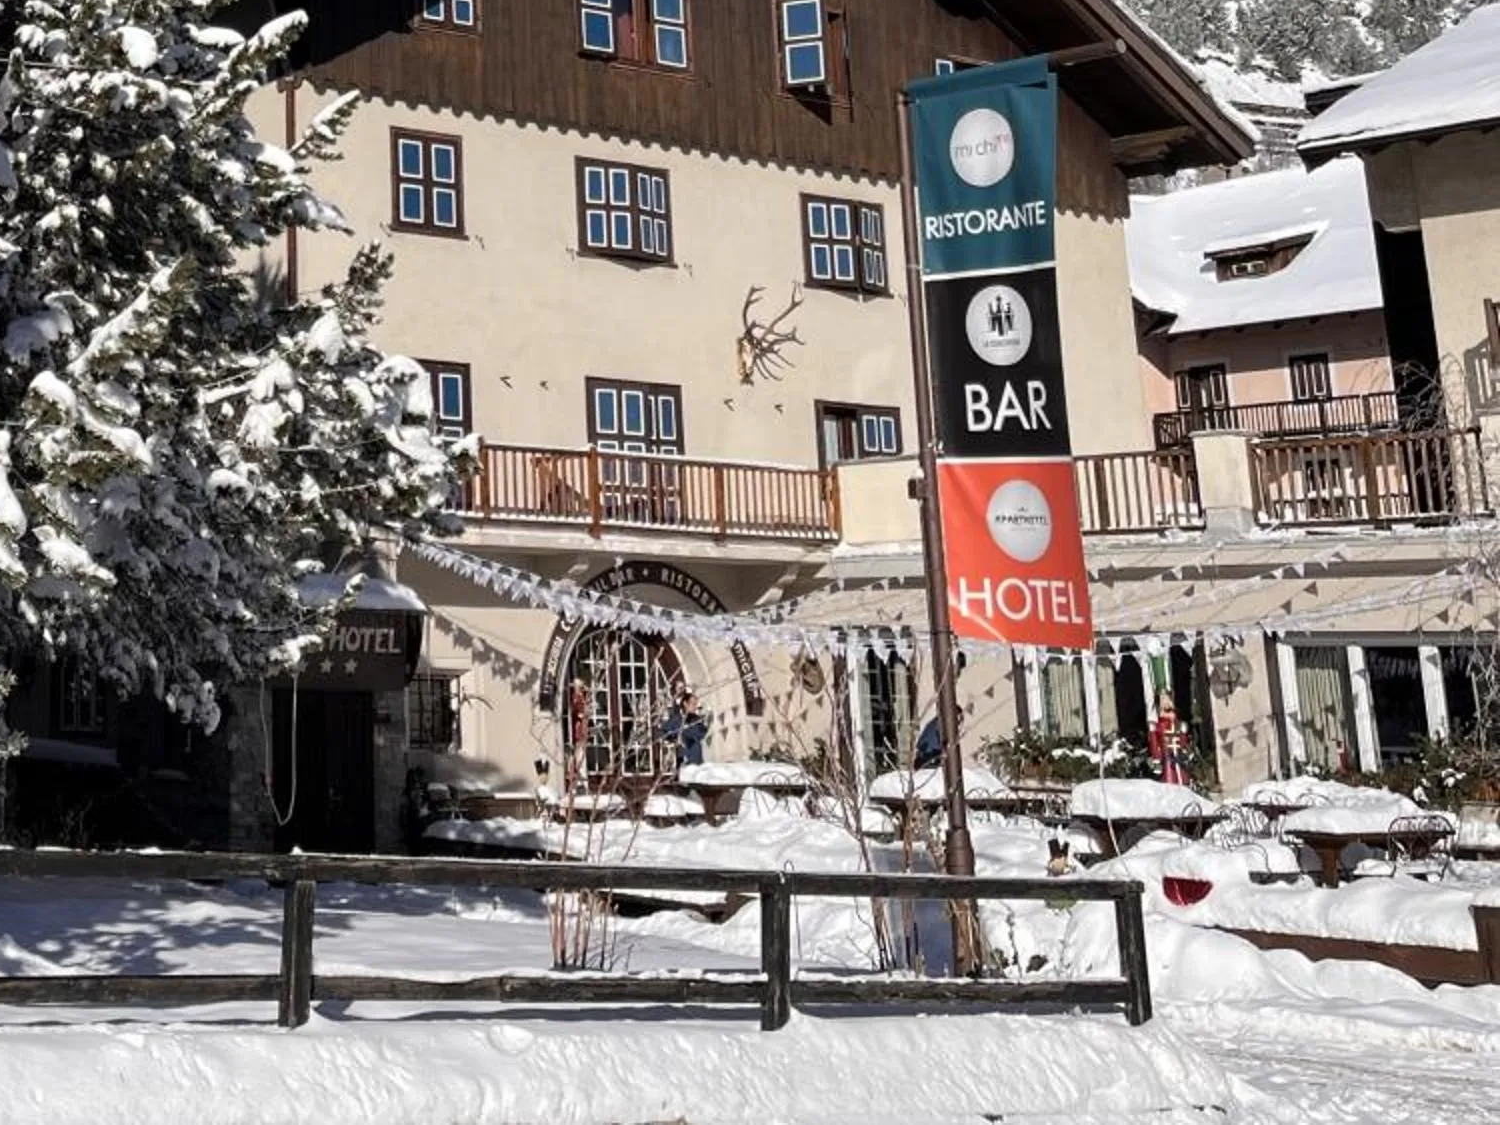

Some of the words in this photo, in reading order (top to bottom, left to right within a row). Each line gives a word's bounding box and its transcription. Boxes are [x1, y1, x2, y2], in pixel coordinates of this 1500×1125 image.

[925, 200, 1046, 240] RISTORANTE
[964, 380, 1053, 432] BAR
[959, 576, 1085, 624] HOTEL
